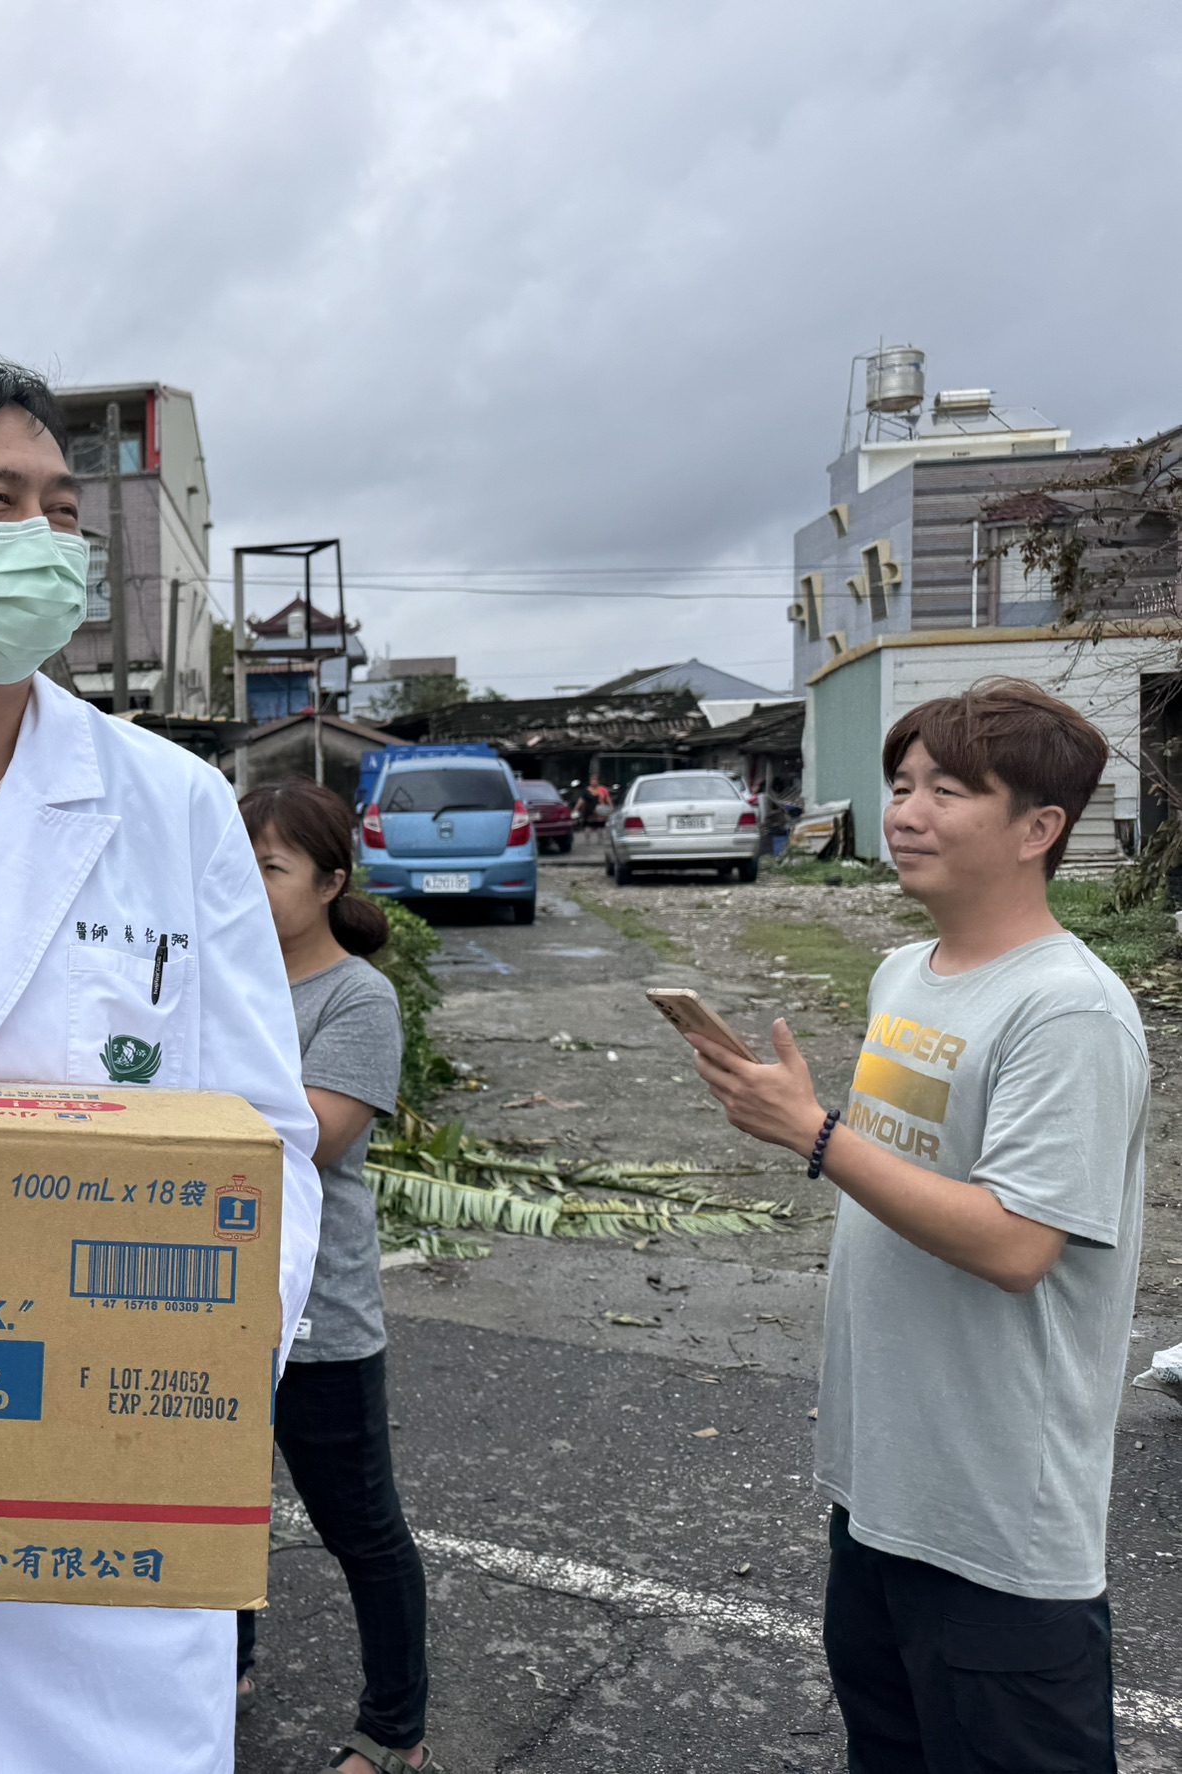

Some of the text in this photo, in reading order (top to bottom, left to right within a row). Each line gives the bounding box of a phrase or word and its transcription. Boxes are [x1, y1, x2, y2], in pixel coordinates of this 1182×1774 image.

[75, 921, 109, 943] 醫師
[849, 1101, 940, 1162] RMOUR
[11, 1174, 70, 1201] 1000
[77, 1178, 115, 1203] mL
[102, 1300, 116, 1309] 47
[124, 1300, 158, 1311] 15718
[165, 1302, 199, 1313] 00309
[205, 1303, 213, 1313] 2
[80, 1367, 90, 1388] F
[108, 1392, 239, 1421] EXP.20270902
